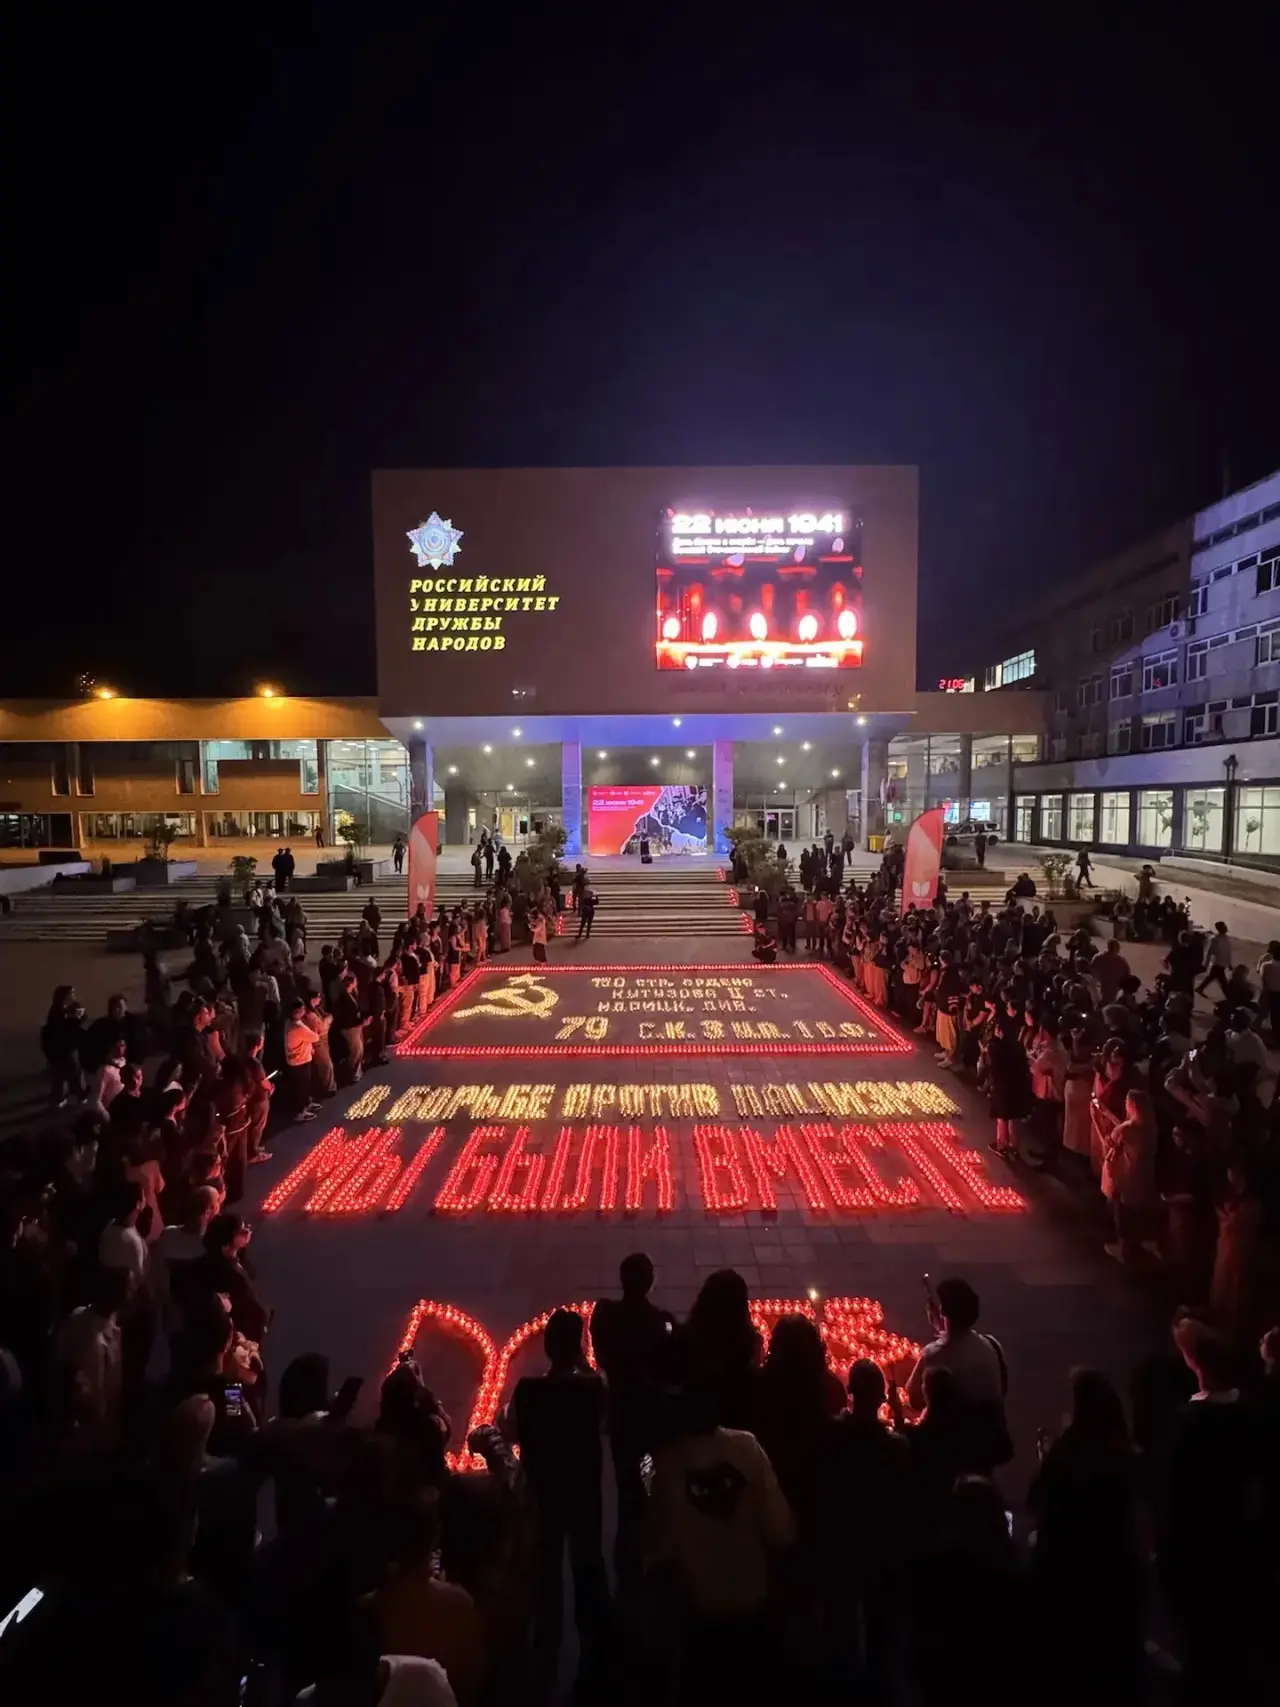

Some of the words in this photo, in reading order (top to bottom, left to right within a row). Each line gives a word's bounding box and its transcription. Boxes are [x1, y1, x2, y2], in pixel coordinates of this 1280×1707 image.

[672, 514, 712, 534] 22
[788, 514, 843, 534] 1941
[409, 575, 547, 593] РОССИЙСКИЙ
[410, 597, 560, 612] УНИВЕРСИТЕТ
[411, 617, 503, 631] ДРУЖБЫ
[412, 637, 506, 651] НАРОДОВ
[555, 1017, 609, 1040] 79
[385, 1084, 556, 1121] БОРЬБЕ
[562, 1083, 719, 1119] ПРОТИВ
[731, 1081, 963, 1117] НАЦИЗМА
[262, 1126, 447, 1212] МЫ
[435, 1125, 674, 1210] БЫЛИ
[693, 1122, 1027, 1209] ВМЕСТЕ
